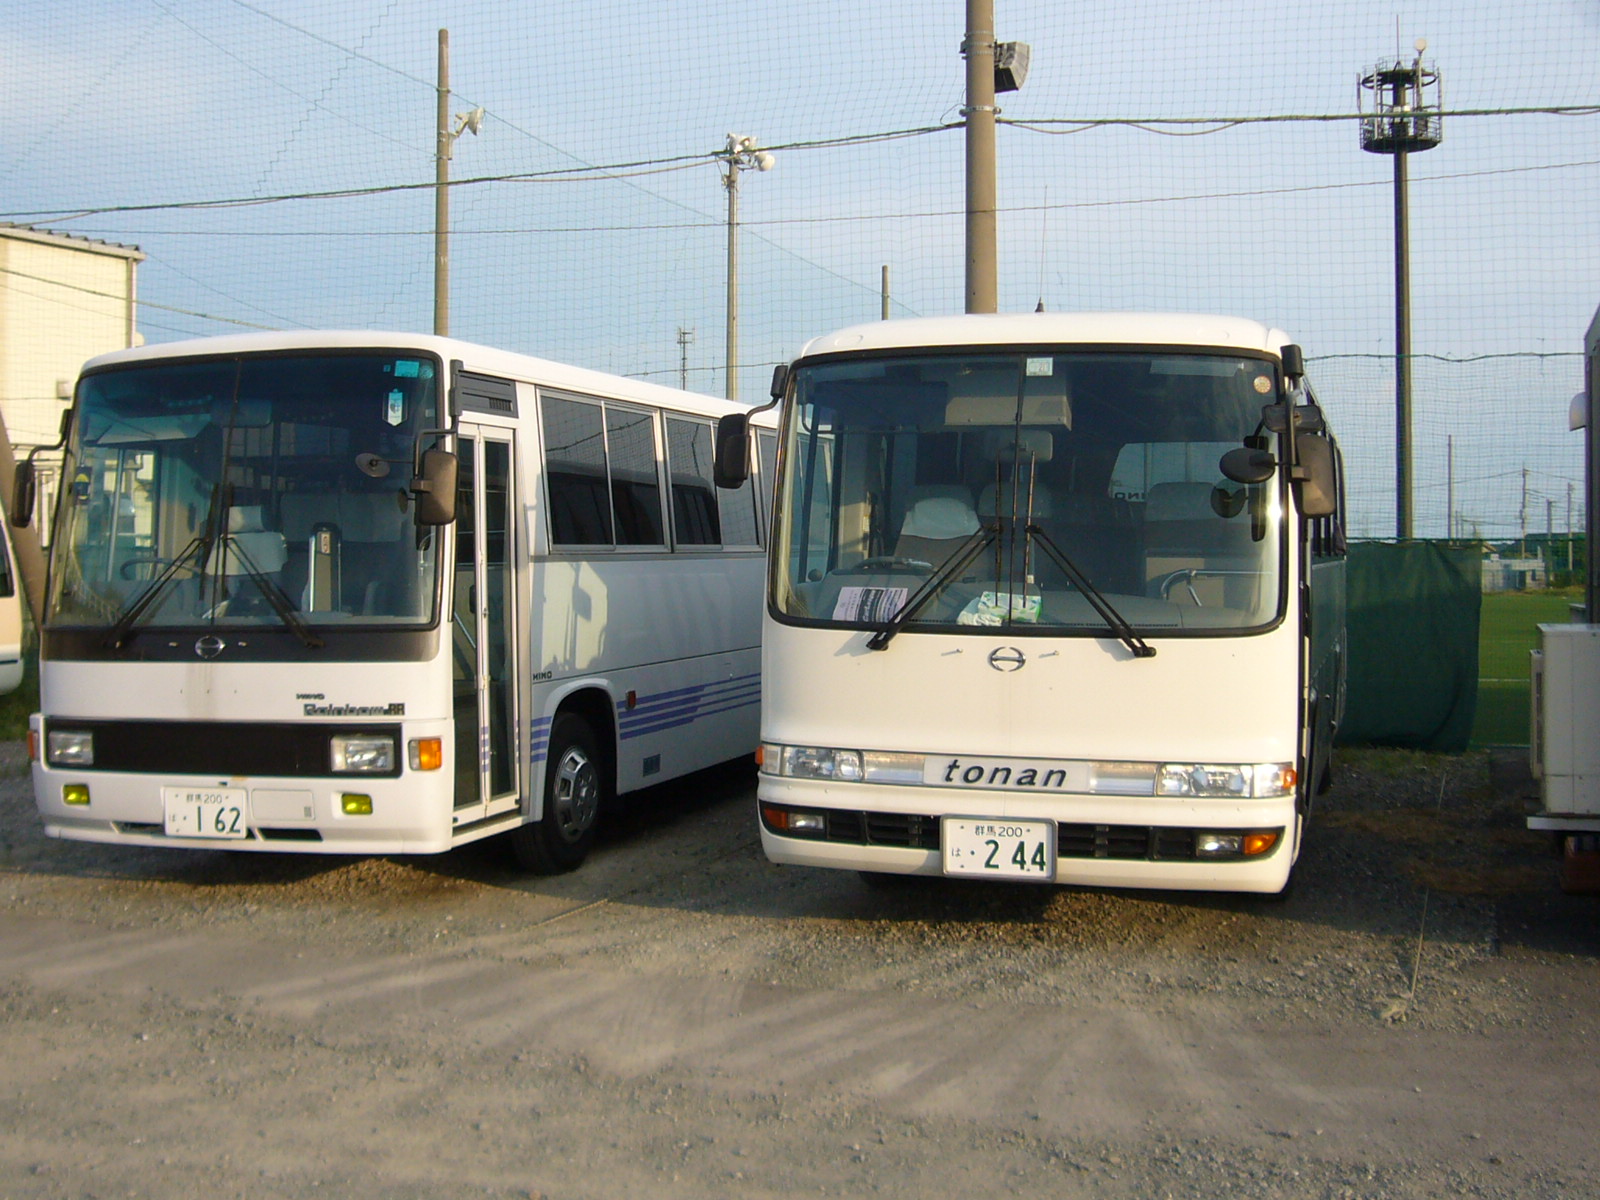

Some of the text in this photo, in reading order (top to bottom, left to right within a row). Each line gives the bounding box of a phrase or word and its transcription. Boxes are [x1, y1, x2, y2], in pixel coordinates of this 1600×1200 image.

[532, 670, 553, 681] HINO
[944, 759, 1067, 787] tonan
[197, 805, 242, 834] 162
[984, 839, 1046, 871] 244
